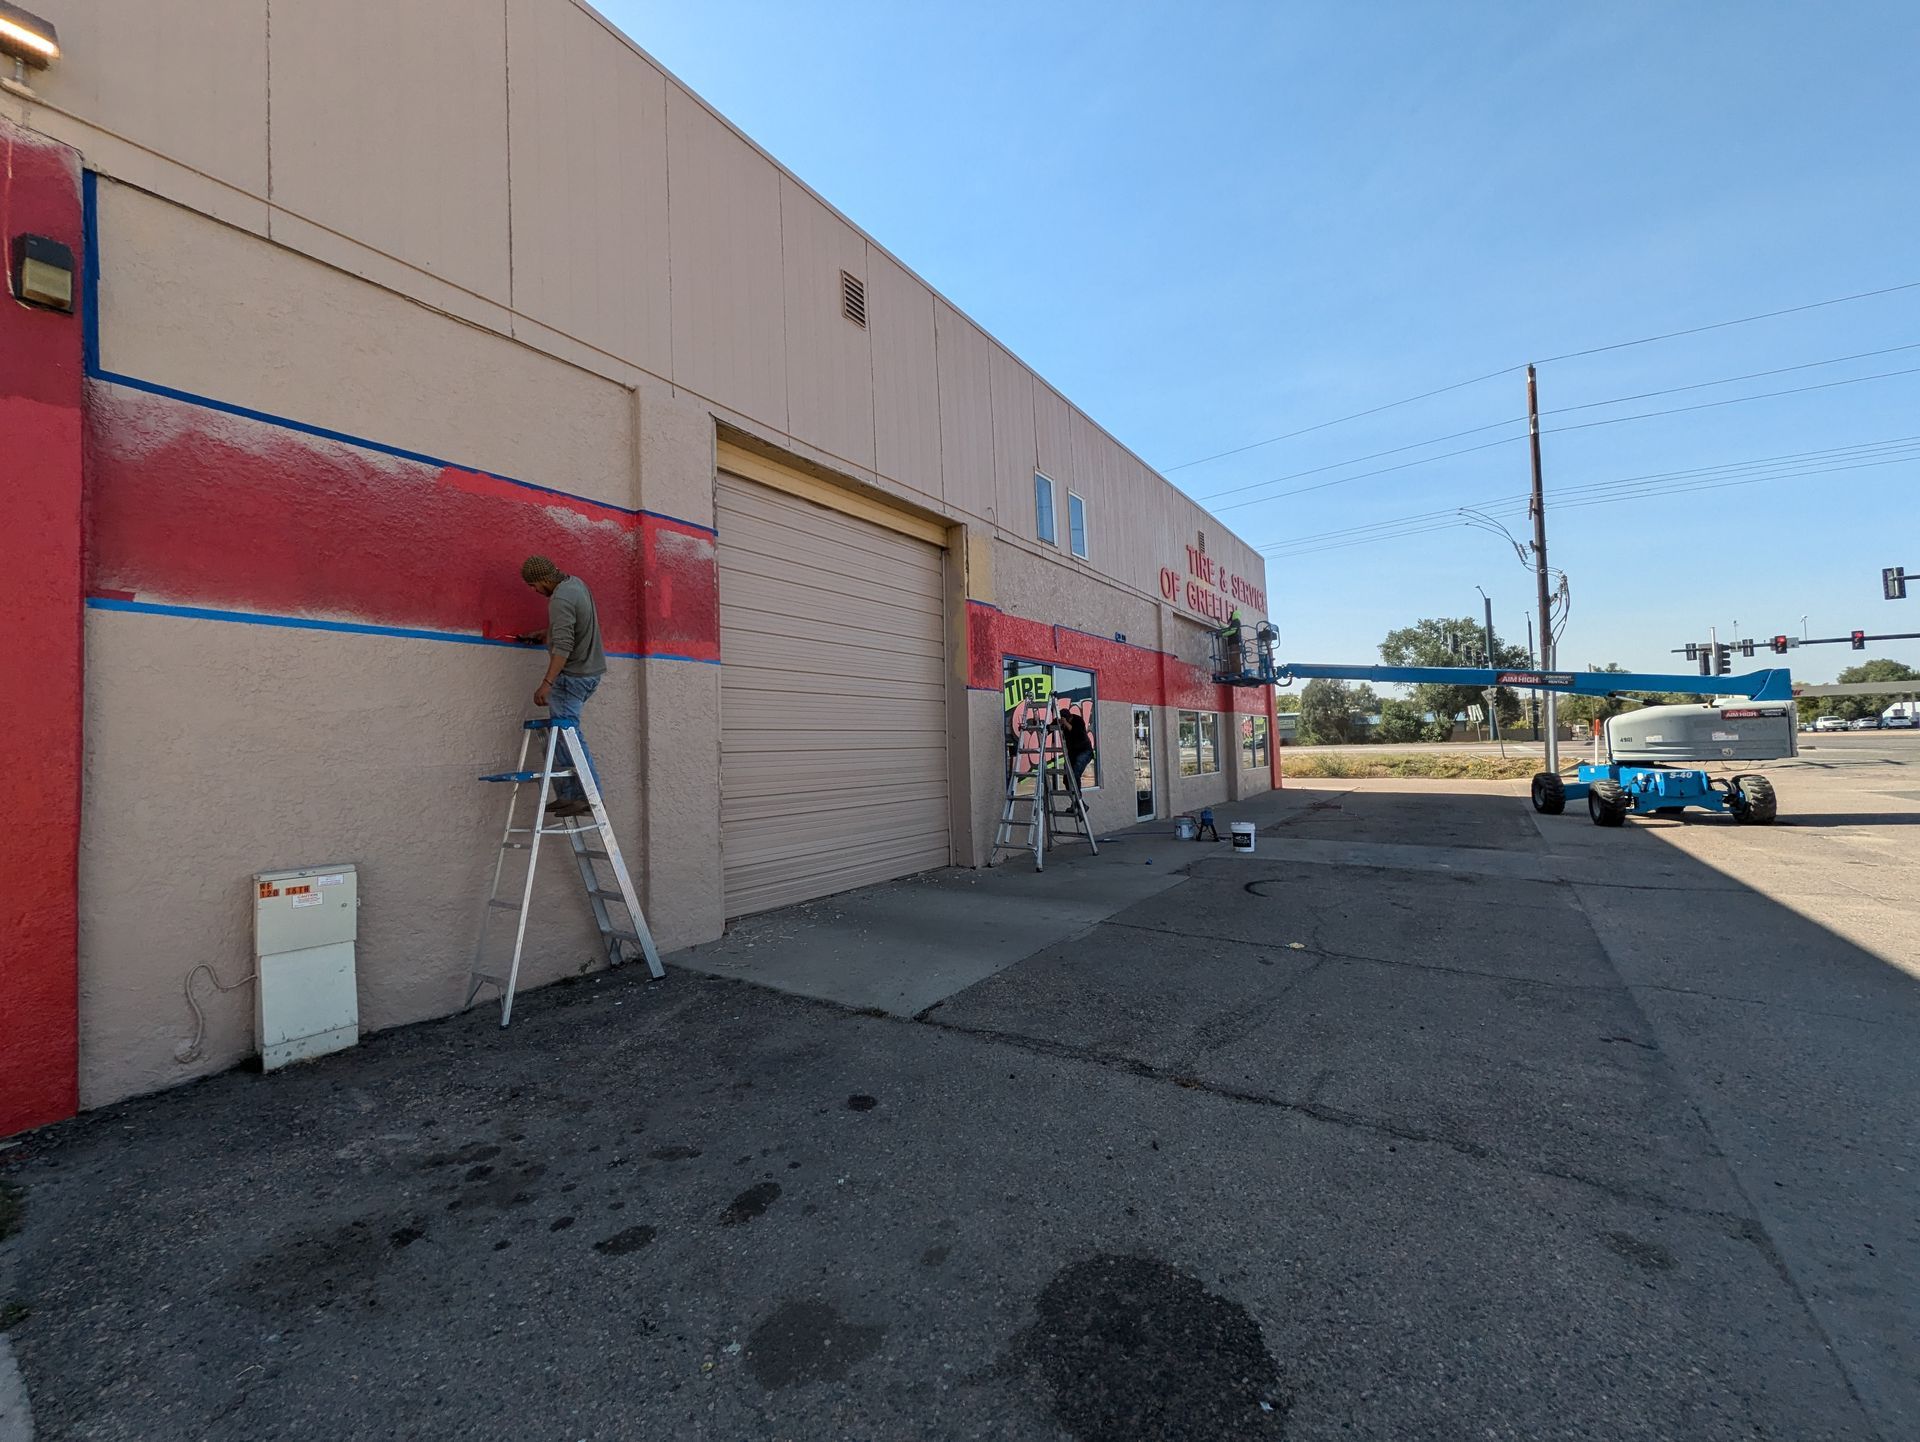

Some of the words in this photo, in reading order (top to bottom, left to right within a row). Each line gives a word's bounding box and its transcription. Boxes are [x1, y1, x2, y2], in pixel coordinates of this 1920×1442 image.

[1186, 544, 1216, 587] TIRE
[1219, 566, 1228, 593] &
[1160, 567, 1180, 602] OF
[1004, 677, 1044, 705] TIRE
[1669, 771, 1693, 779] S-40
